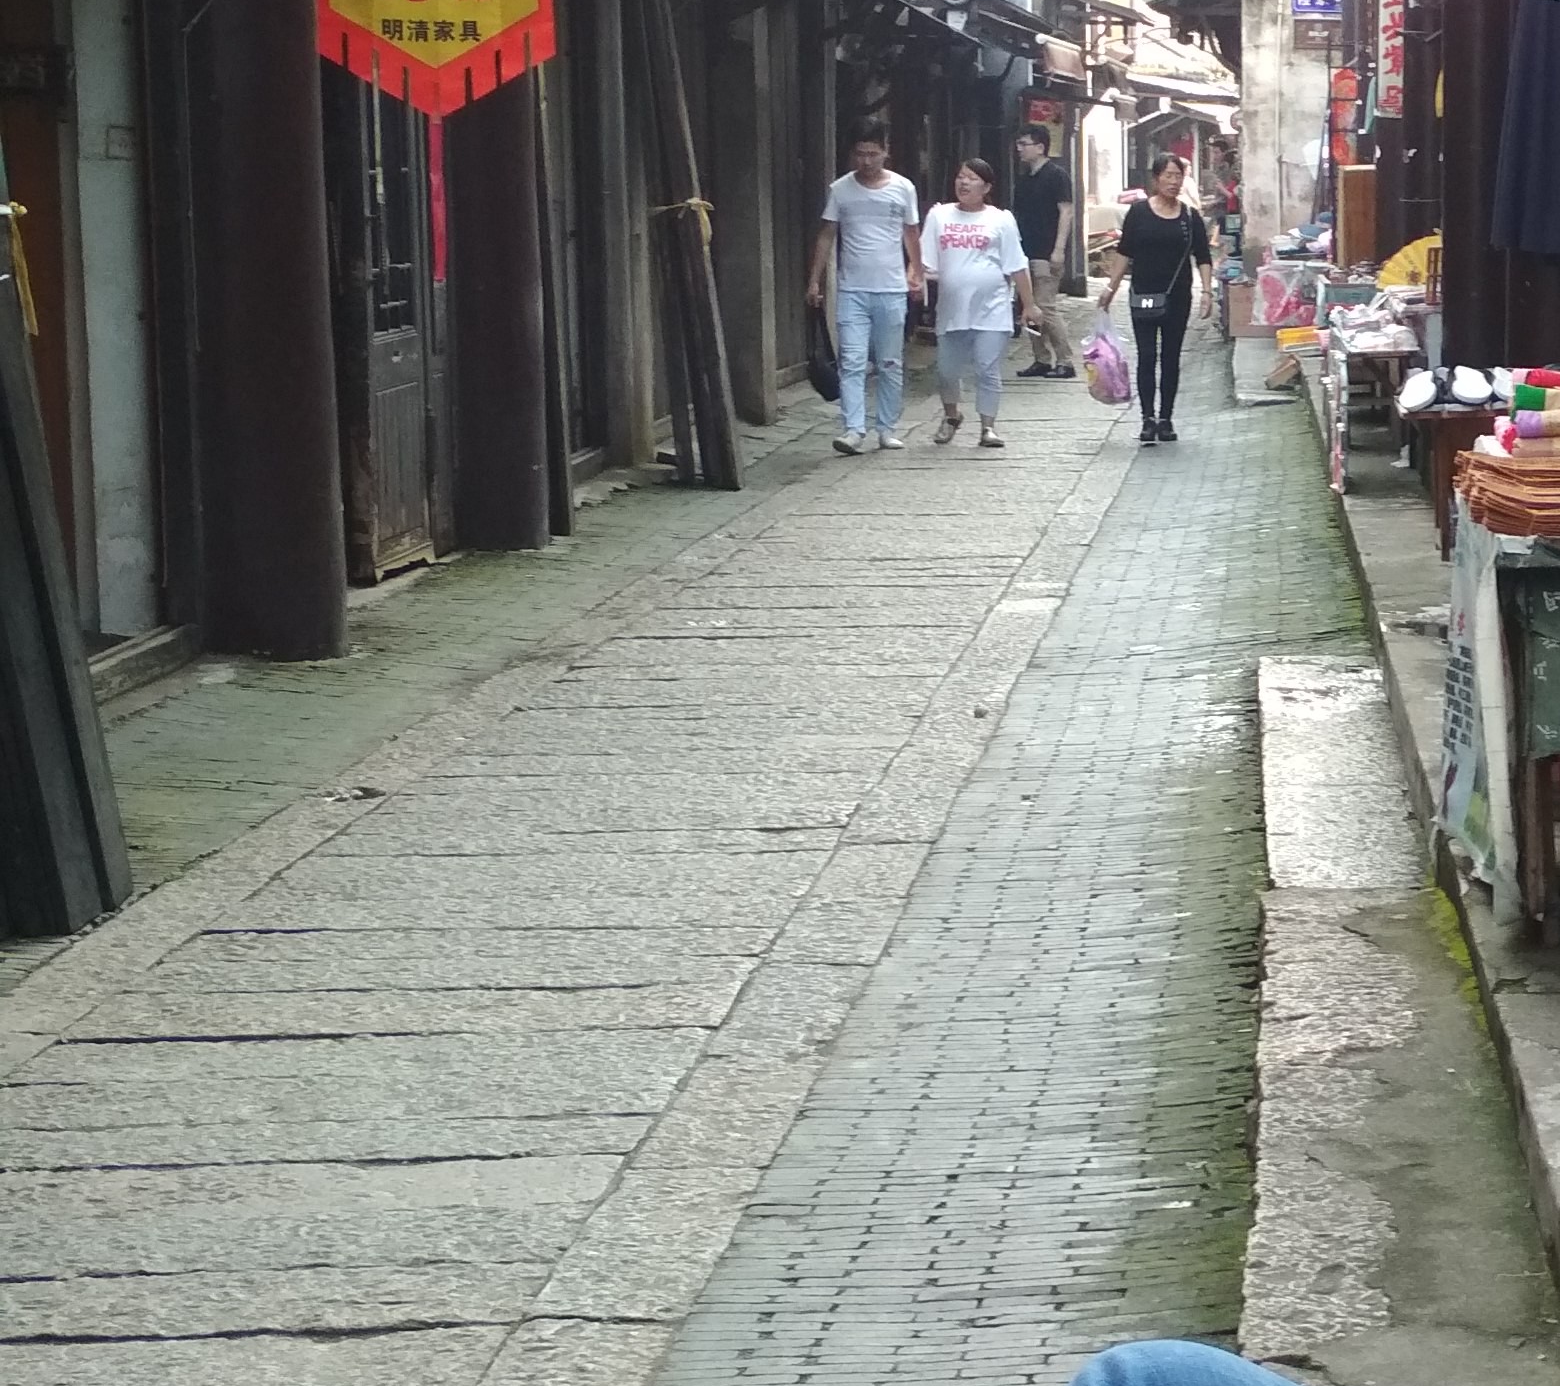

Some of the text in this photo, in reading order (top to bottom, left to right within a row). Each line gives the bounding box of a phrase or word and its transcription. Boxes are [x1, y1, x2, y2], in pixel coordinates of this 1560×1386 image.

[381, 18, 482, 43] 明清家具
[943, 222, 986, 233] HEART
